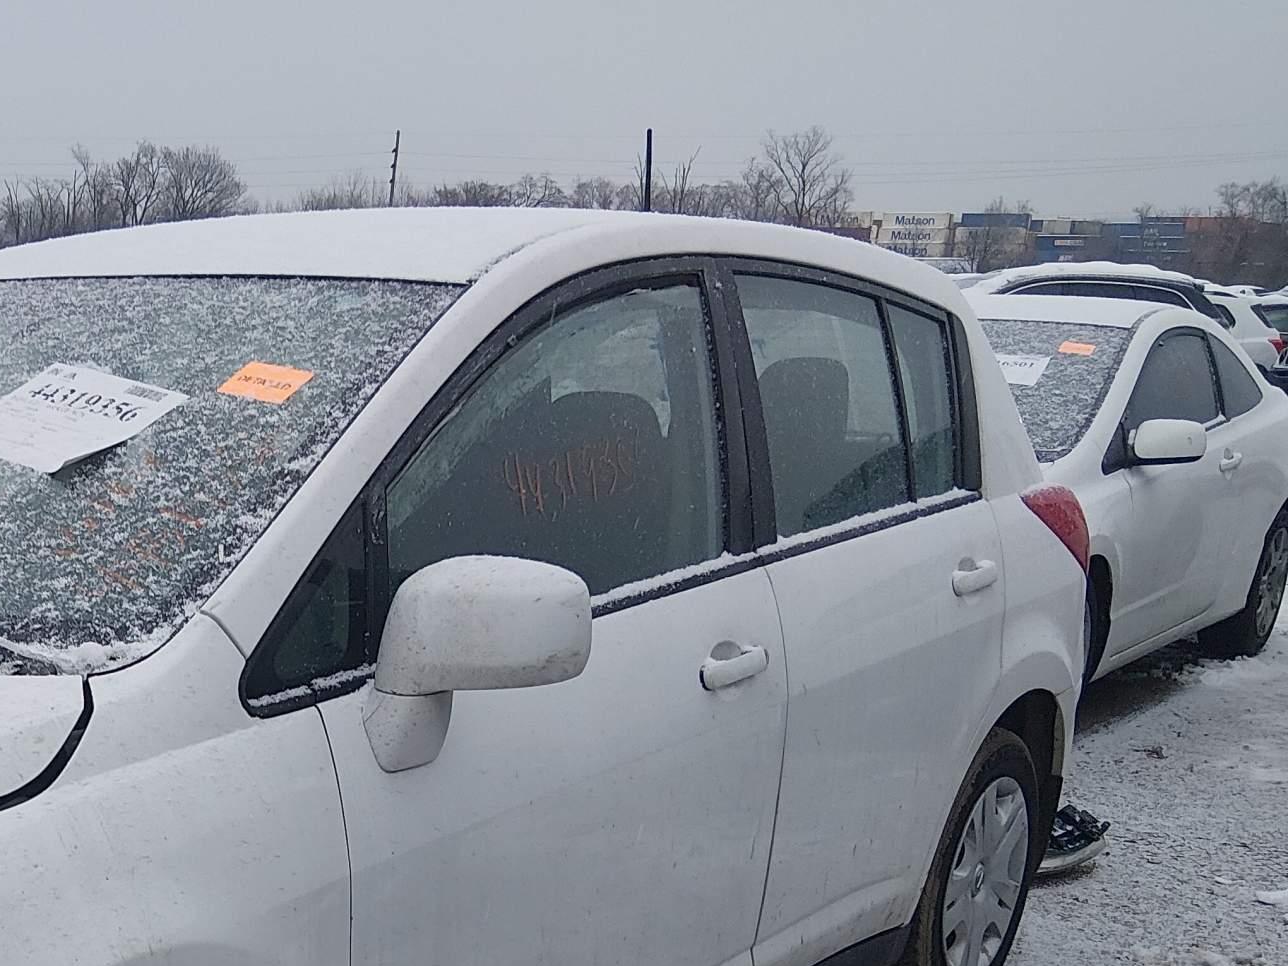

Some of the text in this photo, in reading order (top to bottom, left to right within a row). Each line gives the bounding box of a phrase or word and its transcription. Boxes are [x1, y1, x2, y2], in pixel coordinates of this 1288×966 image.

[895, 215, 935, 225] Matson
[890, 230, 931, 241] Matson
[28, 383, 146, 422] 44319356
